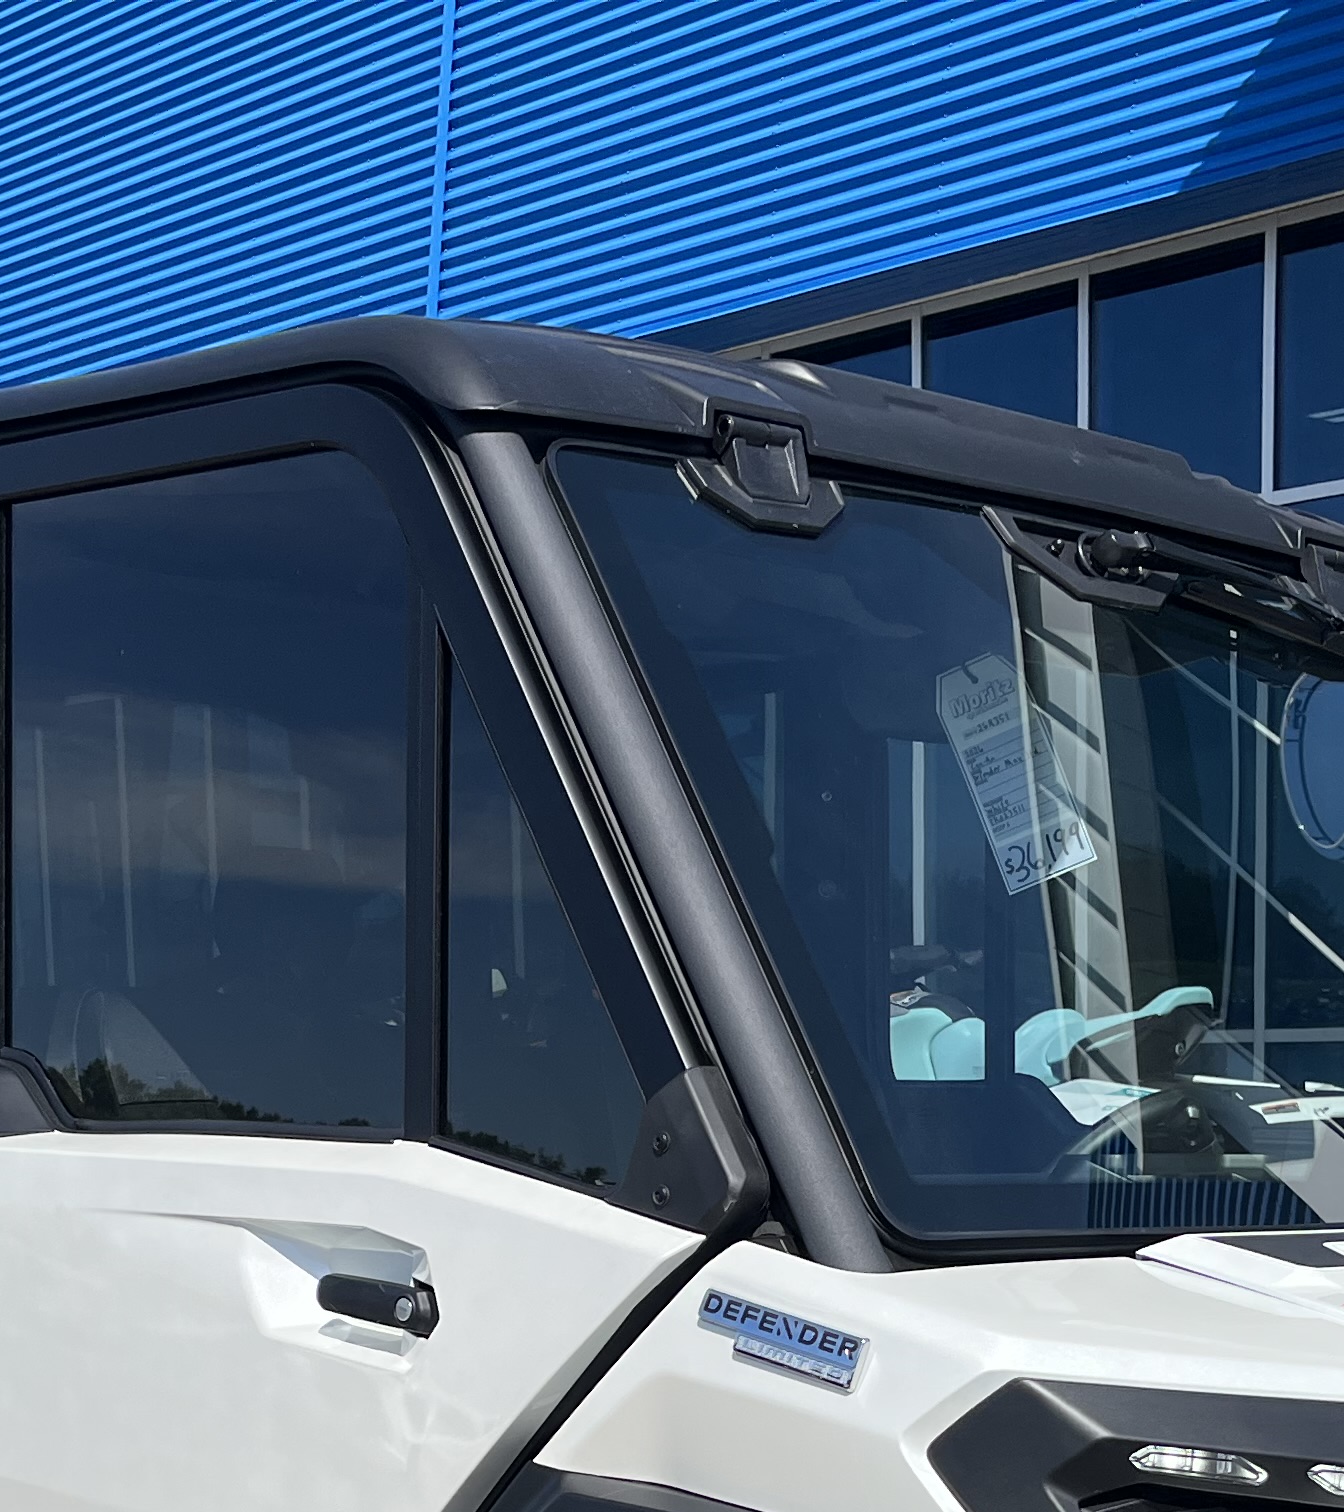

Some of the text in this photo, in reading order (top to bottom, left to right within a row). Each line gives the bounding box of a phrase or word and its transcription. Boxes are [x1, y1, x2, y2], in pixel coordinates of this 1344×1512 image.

[948, 677, 1016, 719] Moritz
[1004, 821, 1085, 883] $36,199
[703, 1293, 859, 1361] DEFENDER
[738, 1336, 851, 1384] LIMITED
